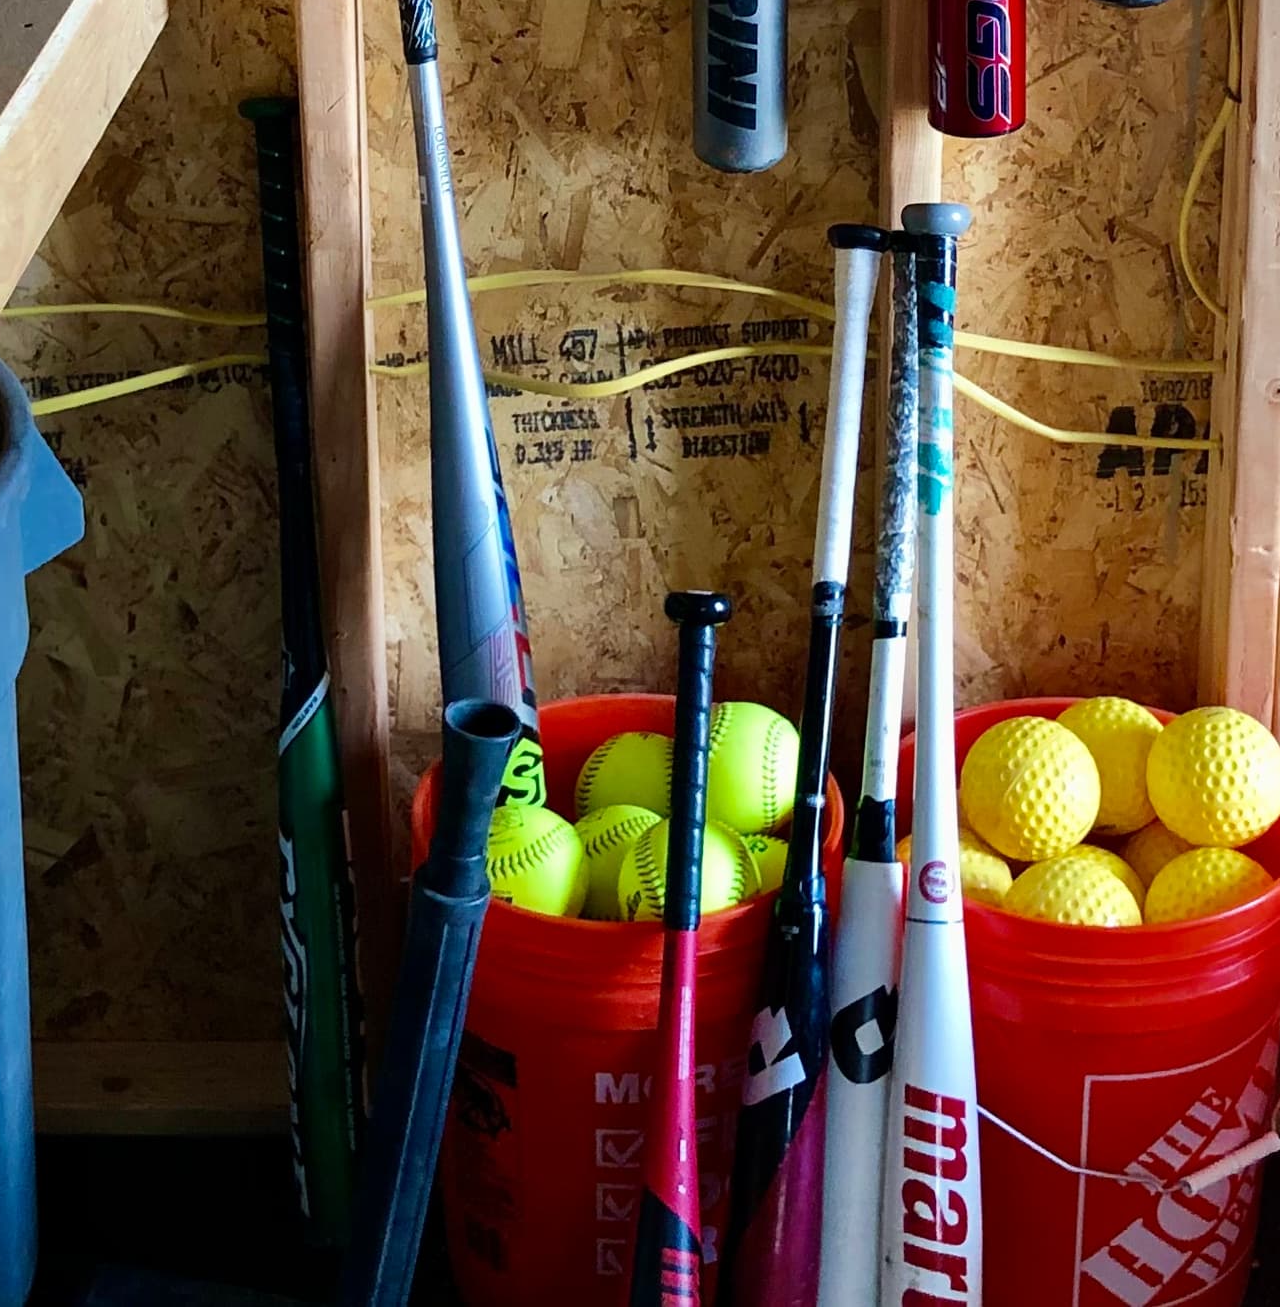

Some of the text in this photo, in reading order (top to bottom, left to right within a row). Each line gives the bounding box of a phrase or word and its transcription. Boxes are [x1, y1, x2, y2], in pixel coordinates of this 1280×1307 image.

[741, 318, 809, 343] SUPPORT
[490, 332, 548, 366] MILL
[903, 1084, 969, 1307] mar
